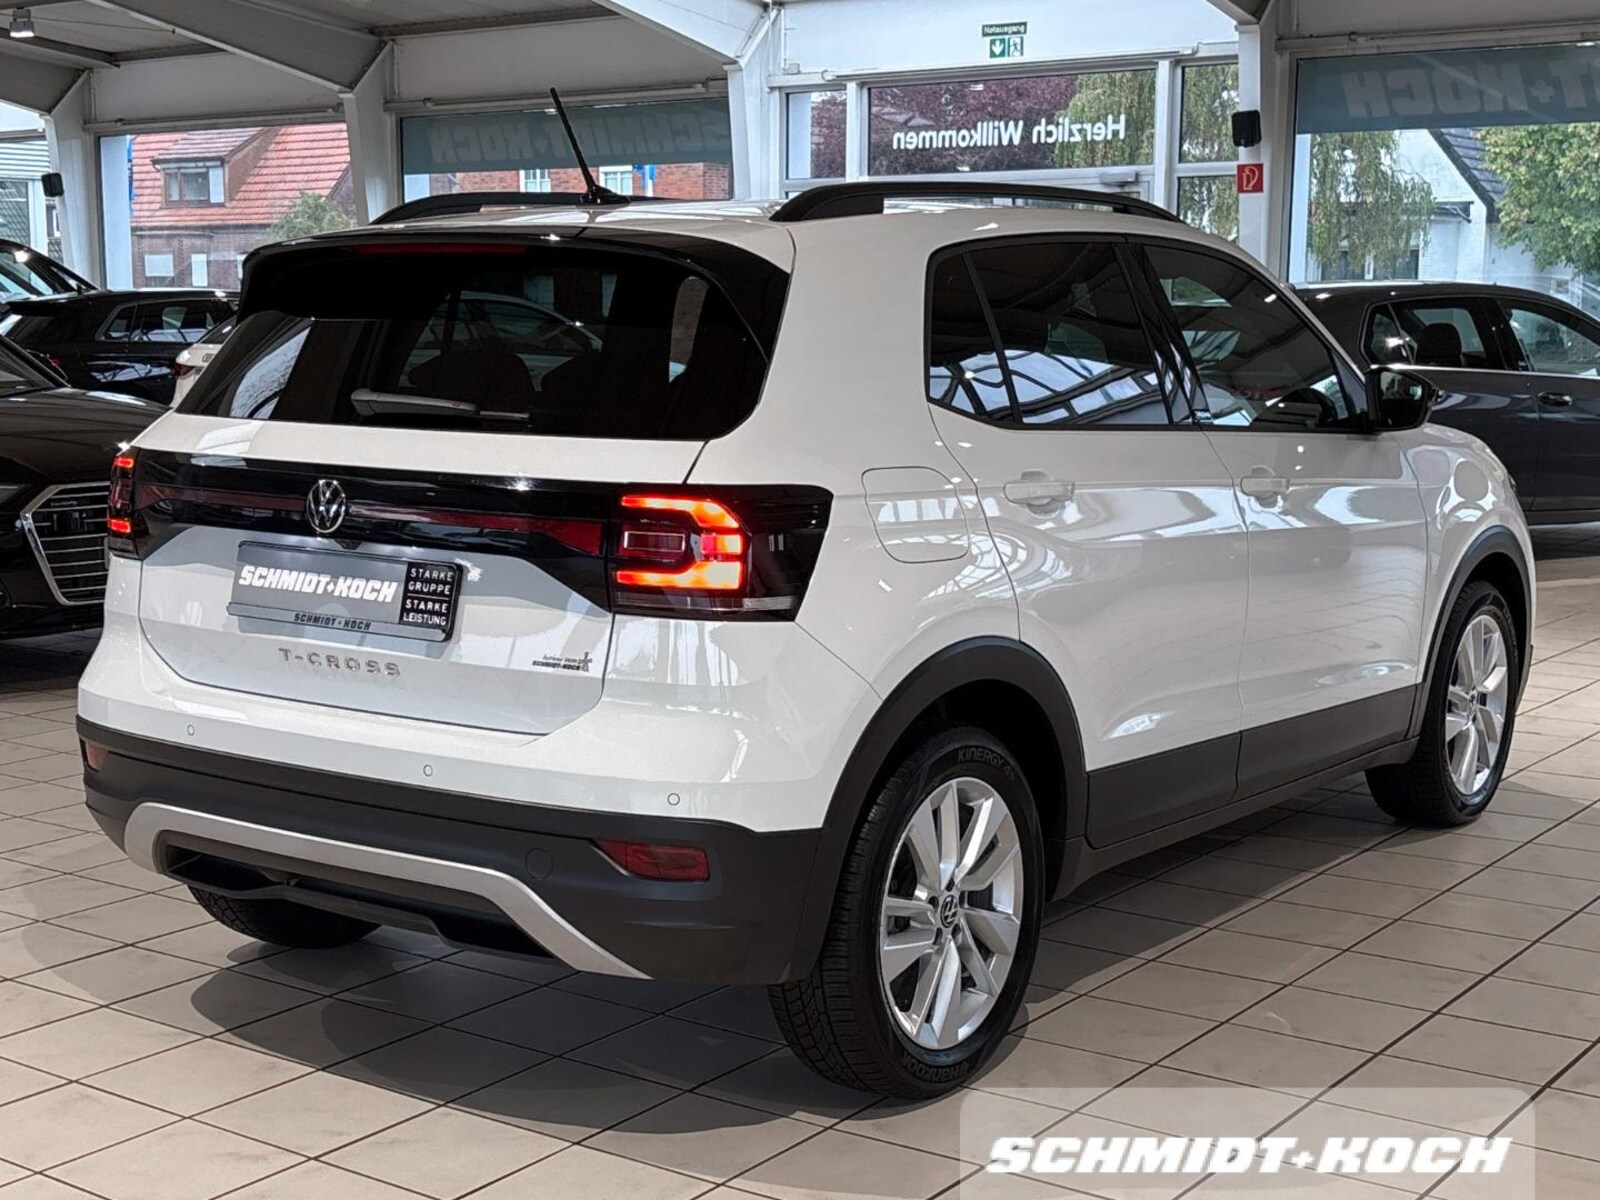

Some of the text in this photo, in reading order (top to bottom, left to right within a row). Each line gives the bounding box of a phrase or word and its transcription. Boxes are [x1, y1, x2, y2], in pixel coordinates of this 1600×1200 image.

[410, 567, 454, 581] STARKE
[238, 565, 399, 603] SCHMIDT+KOCH
[408, 580, 451, 595] GRUPPE
[405, 598, 448, 613] STARKE
[402, 612, 447, 626] LEISTUNG
[278, 647, 401, 677] T-CROSS
[958, 747, 1004, 767] KINERGY
